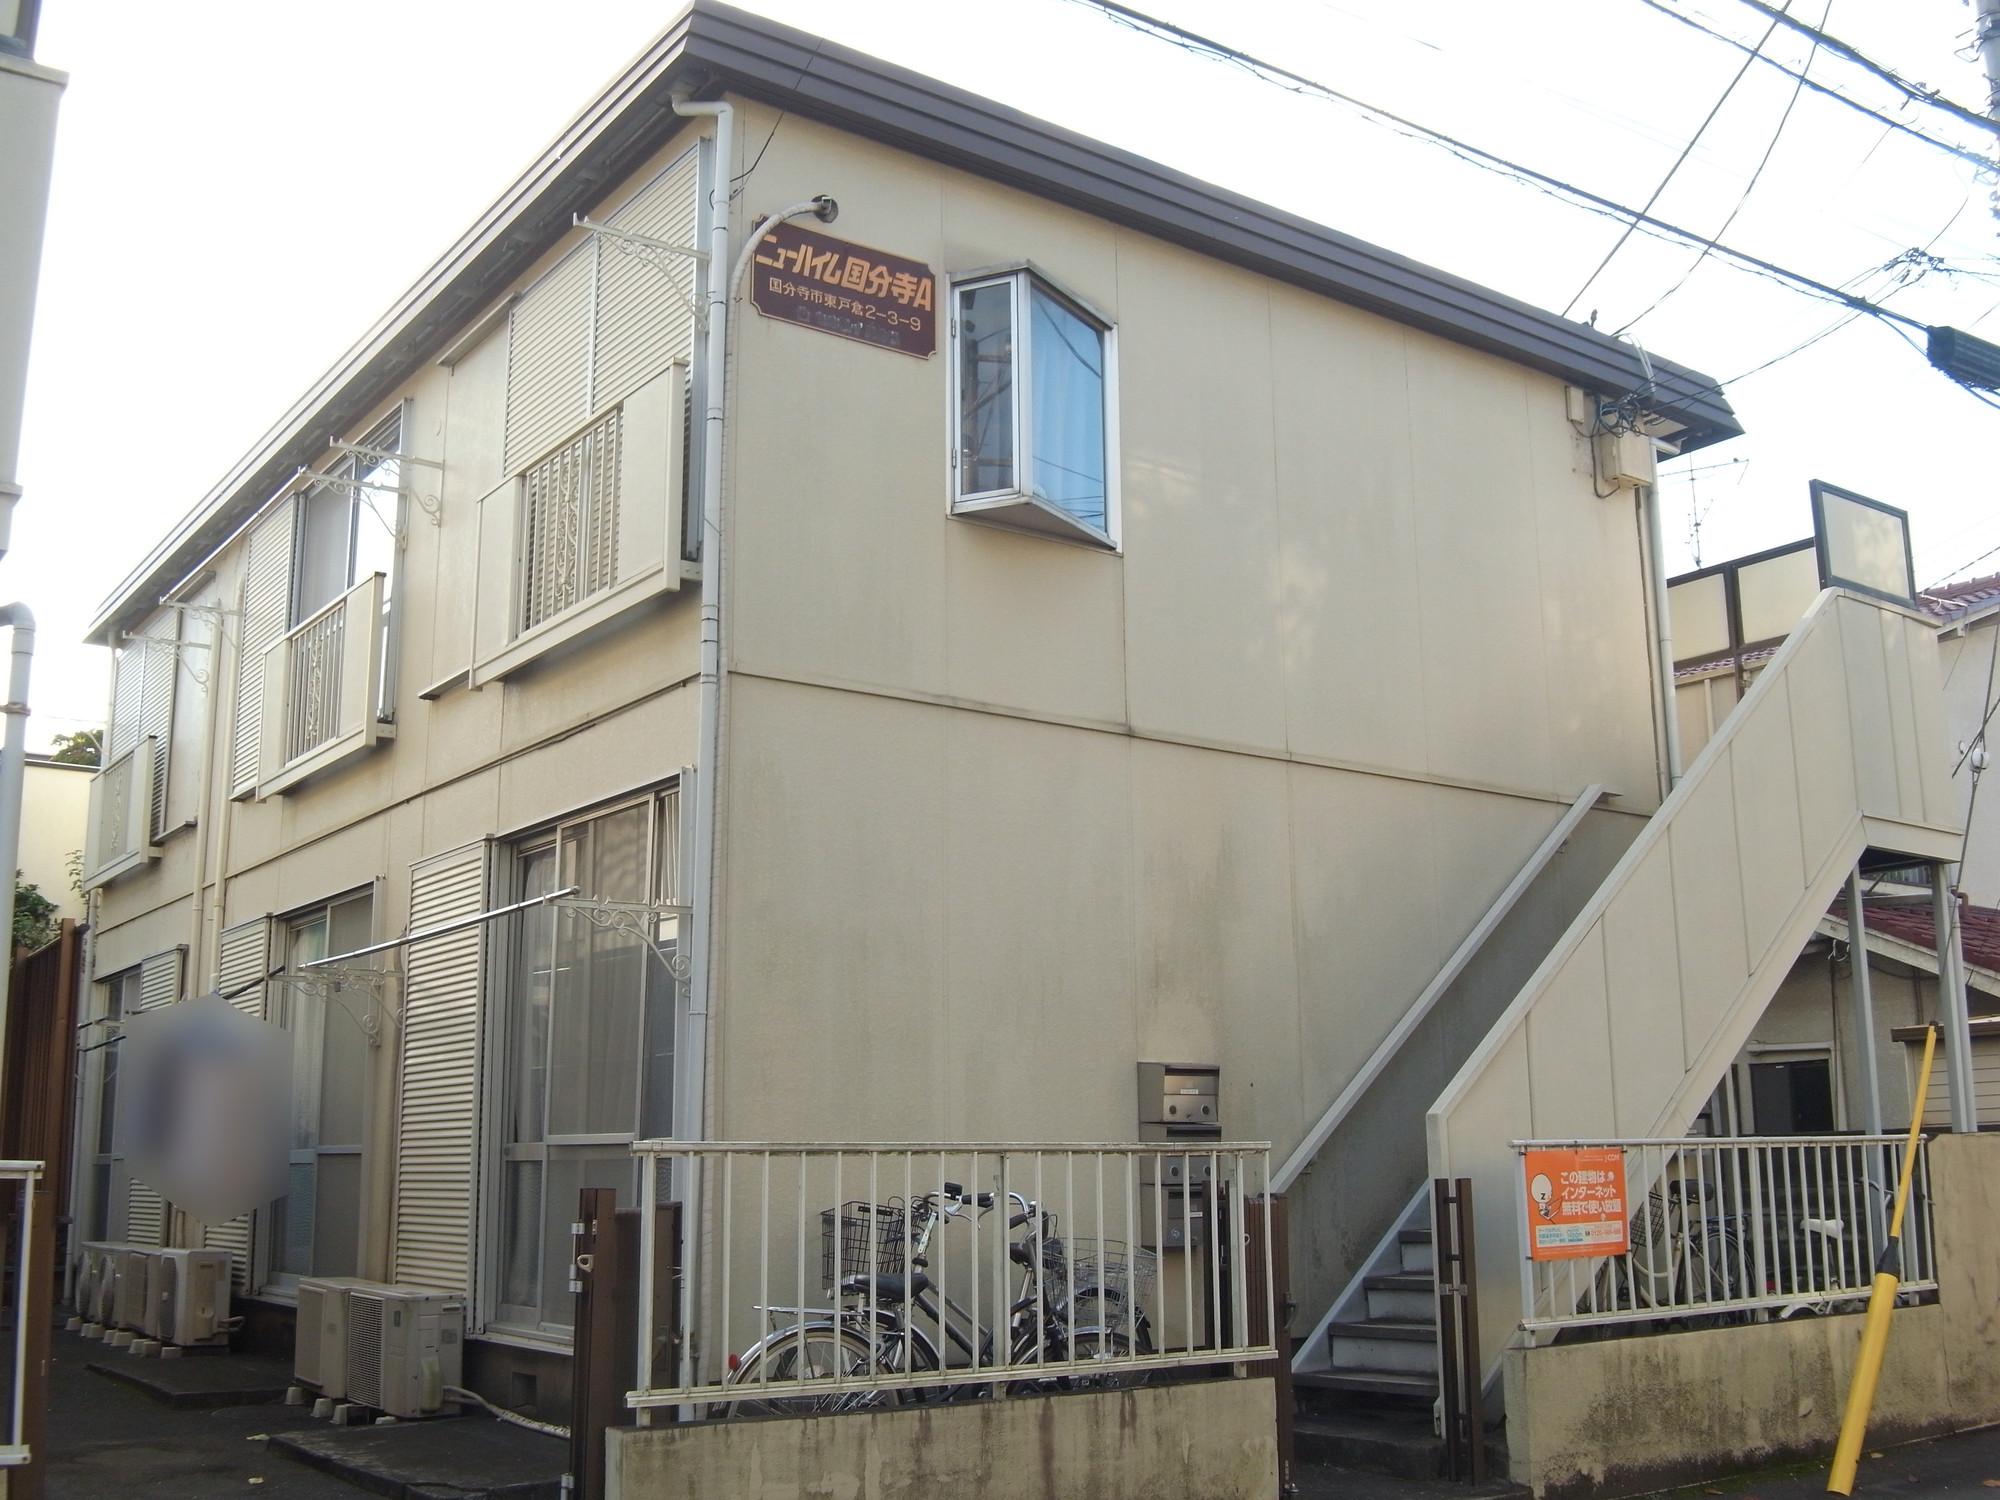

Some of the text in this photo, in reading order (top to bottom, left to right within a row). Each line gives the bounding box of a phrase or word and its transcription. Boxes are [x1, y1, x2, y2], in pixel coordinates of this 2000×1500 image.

[1561, 1184, 1617, 1200] インターネット
